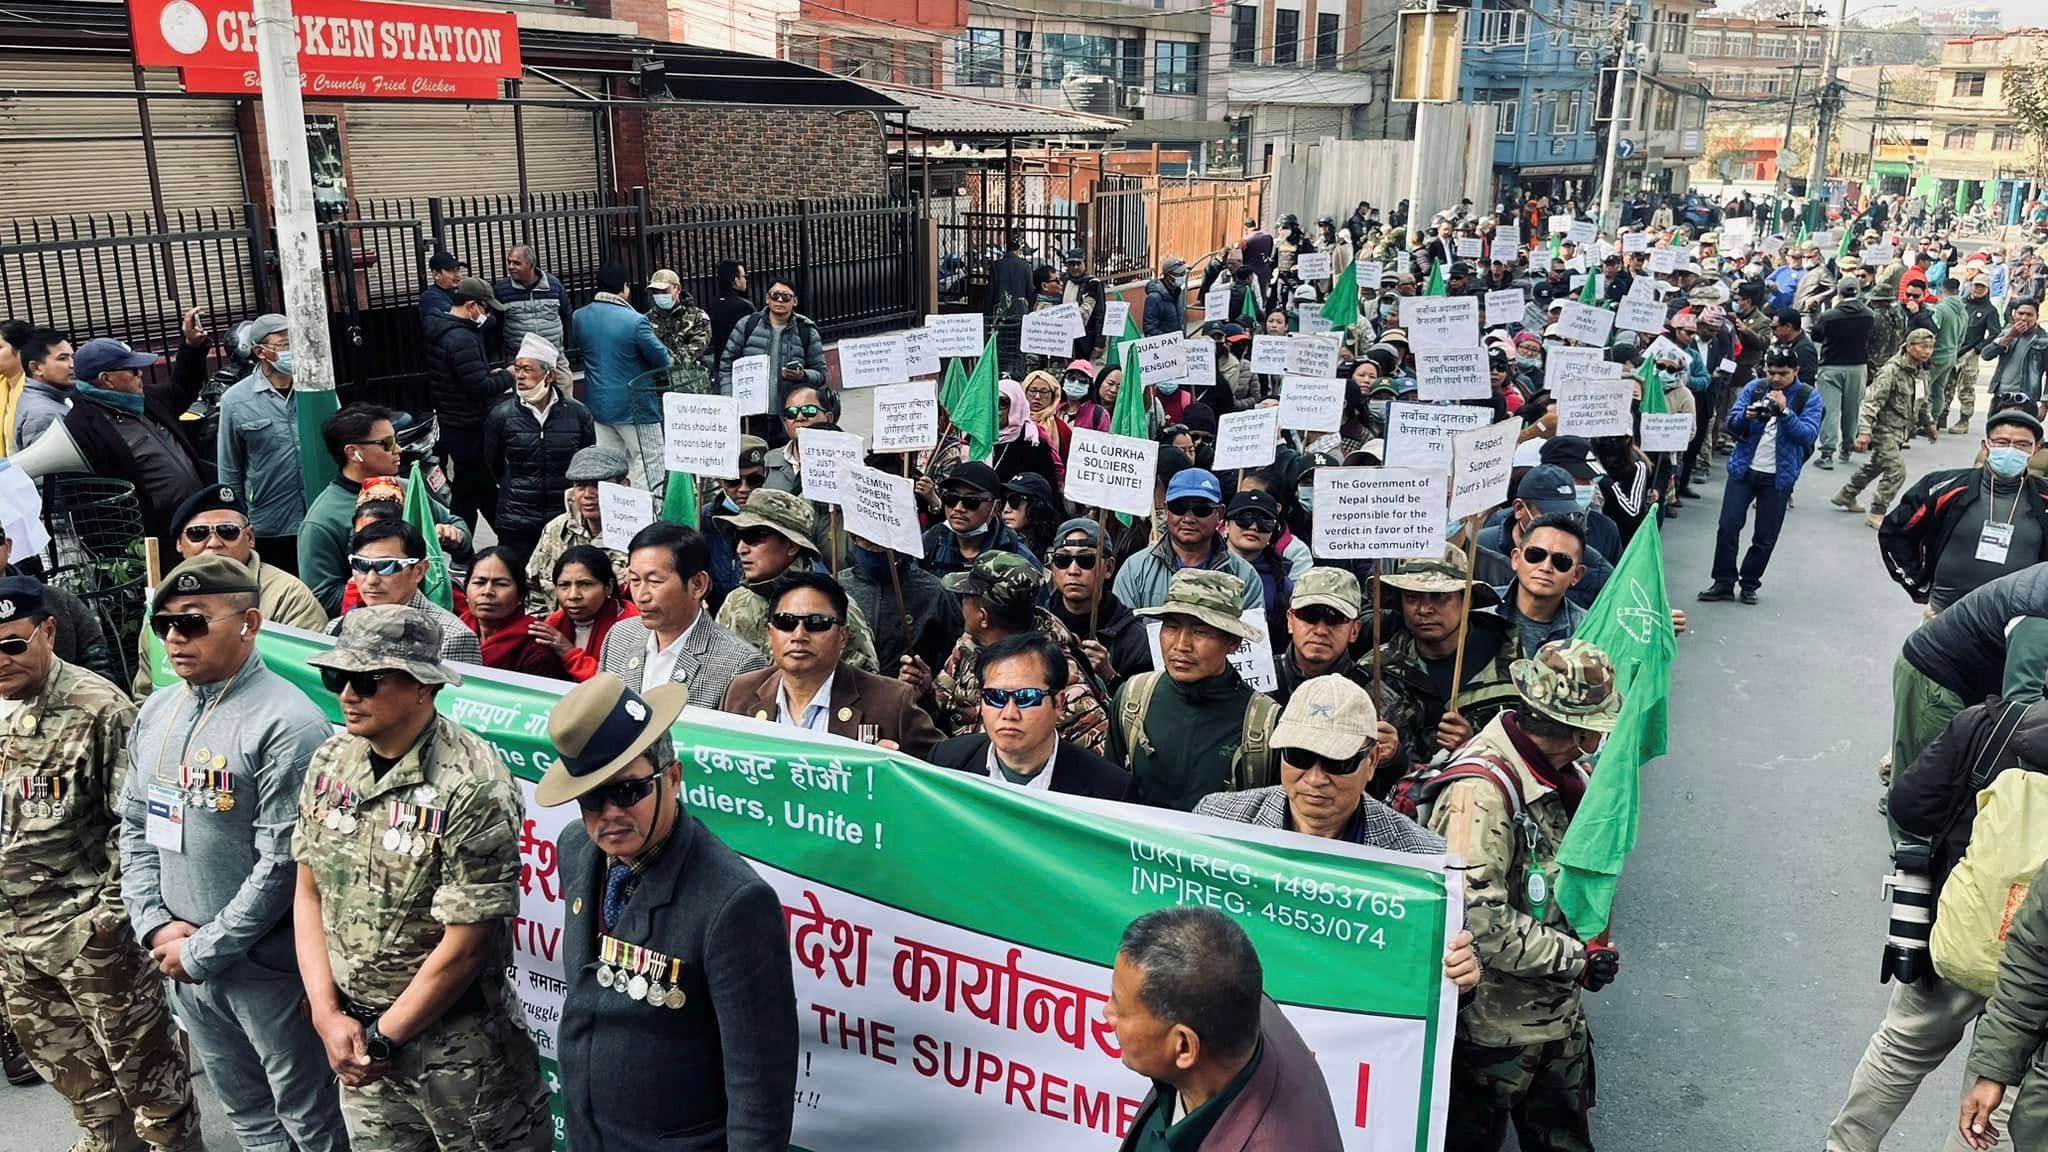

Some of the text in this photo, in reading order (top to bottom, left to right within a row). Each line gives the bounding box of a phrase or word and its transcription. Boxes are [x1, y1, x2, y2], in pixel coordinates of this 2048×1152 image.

[217, 10, 502, 64] CHKEN STATION
[314, 74, 367, 92] Crunchy
[372, 75, 406, 92] Fried
[412, 76, 457, 93] Chicken
[1137, 336, 1179, 353] QUAL PAY
[1400, 409, 1478, 425] सर्वोच्च अदालतको
[1570, 410, 1602, 418] EQUALITY
[672, 422, 728, 433] states should be
[674, 439, 726, 449] responsible for
[1078, 442, 1145, 461] ALL GURKHA
[1474, 436, 1503, 451] Respect
[676, 454, 699, 464] human
[842, 450, 856, 459] FOR
[809, 468, 835, 478] EQUALIT
[1084, 456, 1137, 475] SOLDIERS,
[1469, 456, 1502, 473] Supreme
[1077, 470, 1142, 489] LET'S UNITE!
[1331, 478, 1429, 489] The Government of
[855, 483, 892, 503] SUPREME
[1339, 494, 1421, 506] Nepal should be
[857, 504, 901, 527] DIRECTIVES
[1332, 510, 1427, 521] responsible for the
[1325, 525, 1434, 535] verdict in favor of the
[1329, 540, 1430, 551] Gorkha community!
[694, 744, 776, 785] एकजुट
[490, 741, 525, 766] he
[784, 800, 863, 846] Unite
[873, 821, 883, 850] !
[1130, 837, 1407, 920] [UK] REG: 14953765
[1261, 902, 1387, 950] 4553/074
[811, 1003, 897, 1066] THE
